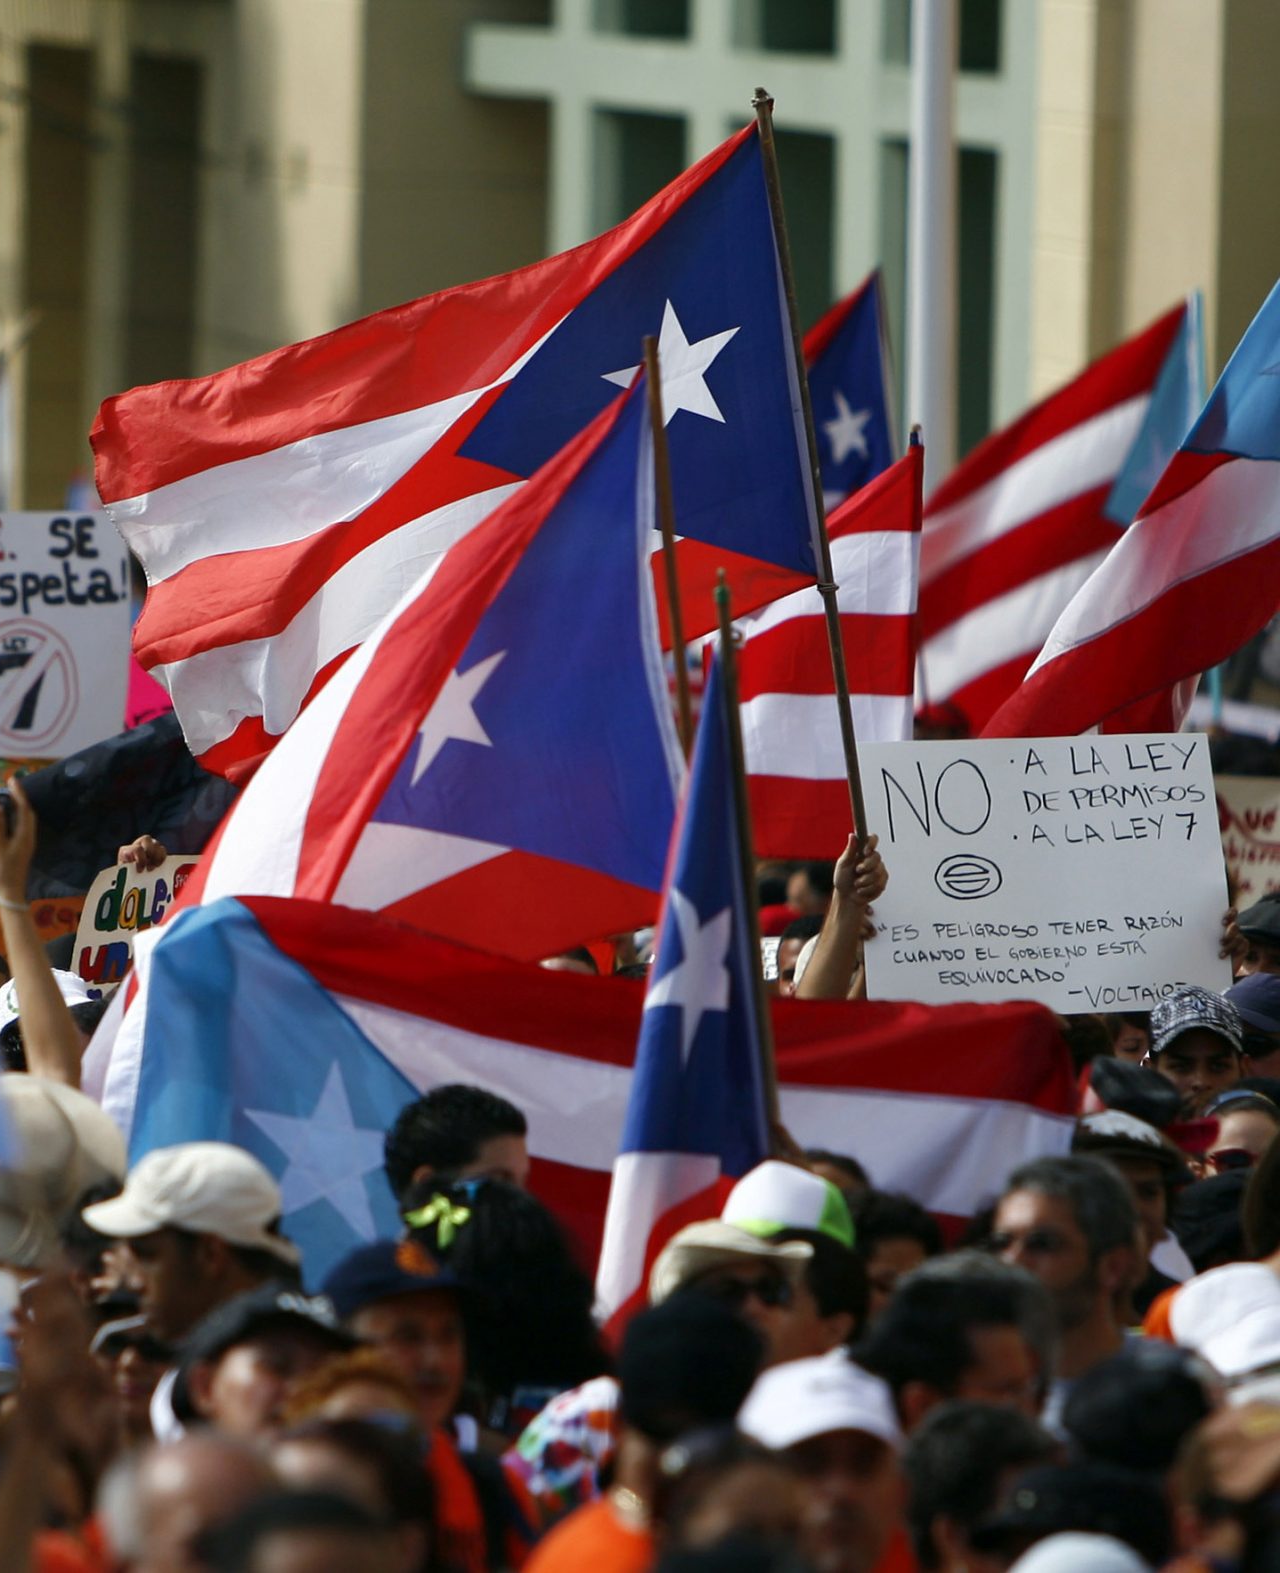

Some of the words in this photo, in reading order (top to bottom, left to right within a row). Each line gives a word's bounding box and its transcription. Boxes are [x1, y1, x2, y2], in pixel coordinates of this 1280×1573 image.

[48, 517, 99, 558] SE
[1025, 748, 1048, 776] A
[1070, 746, 1110, 775] LA
[1125, 742, 1197, 772] LEY
[881, 758, 992, 843] NO
[1023, 790, 1060, 815] DE
[1032, 824, 1055, 847] A
[1065, 823, 1105, 844] LA
[1111, 814, 1164, 841] LEY
[1175, 812, 1198, 841] 7
[1048, 919, 1113, 935] TENER
[1125, 911, 1183, 929] RAZÓN
[893, 949, 965, 964] CUANDO
[976, 948, 999, 960] EL
